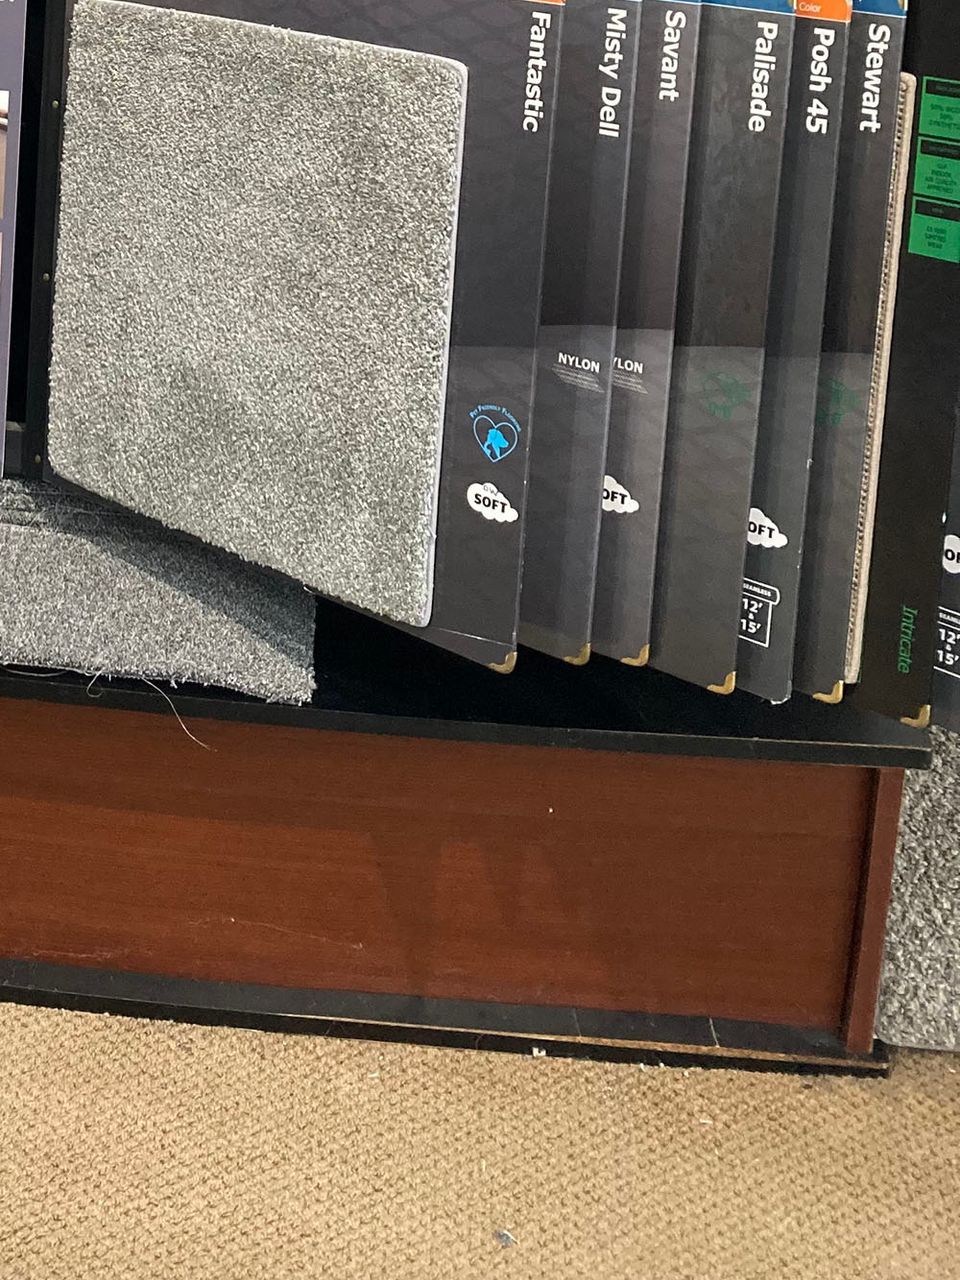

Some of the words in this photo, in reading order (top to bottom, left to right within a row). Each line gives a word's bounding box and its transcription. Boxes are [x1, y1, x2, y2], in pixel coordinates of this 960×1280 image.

[798, 1, 821, 13] Color
[596, 7, 627, 80] Misty
[658, 10, 687, 103] Savant
[522, 11, 552, 133] Fantastic
[808, 26, 835, 91] Posh
[748, 20, 778, 133] Palisade
[859, 23, 890, 133] Stewart
[598, 89, 620, 138] Dell
[806, 97, 829, 135] 45
[558, 352, 600, 373] NYLON
[614, 357, 644, 374] LON
[474, 493, 508, 513] SOFT
[603, 488, 628, 505] OFT
[748, 521, 775, 539] OFT
[742, 598, 763, 613] 12'
[740, 618, 761, 634] 15'
[897, 605, 918, 673] Intricate
[937, 649, 959, 665] 15'
